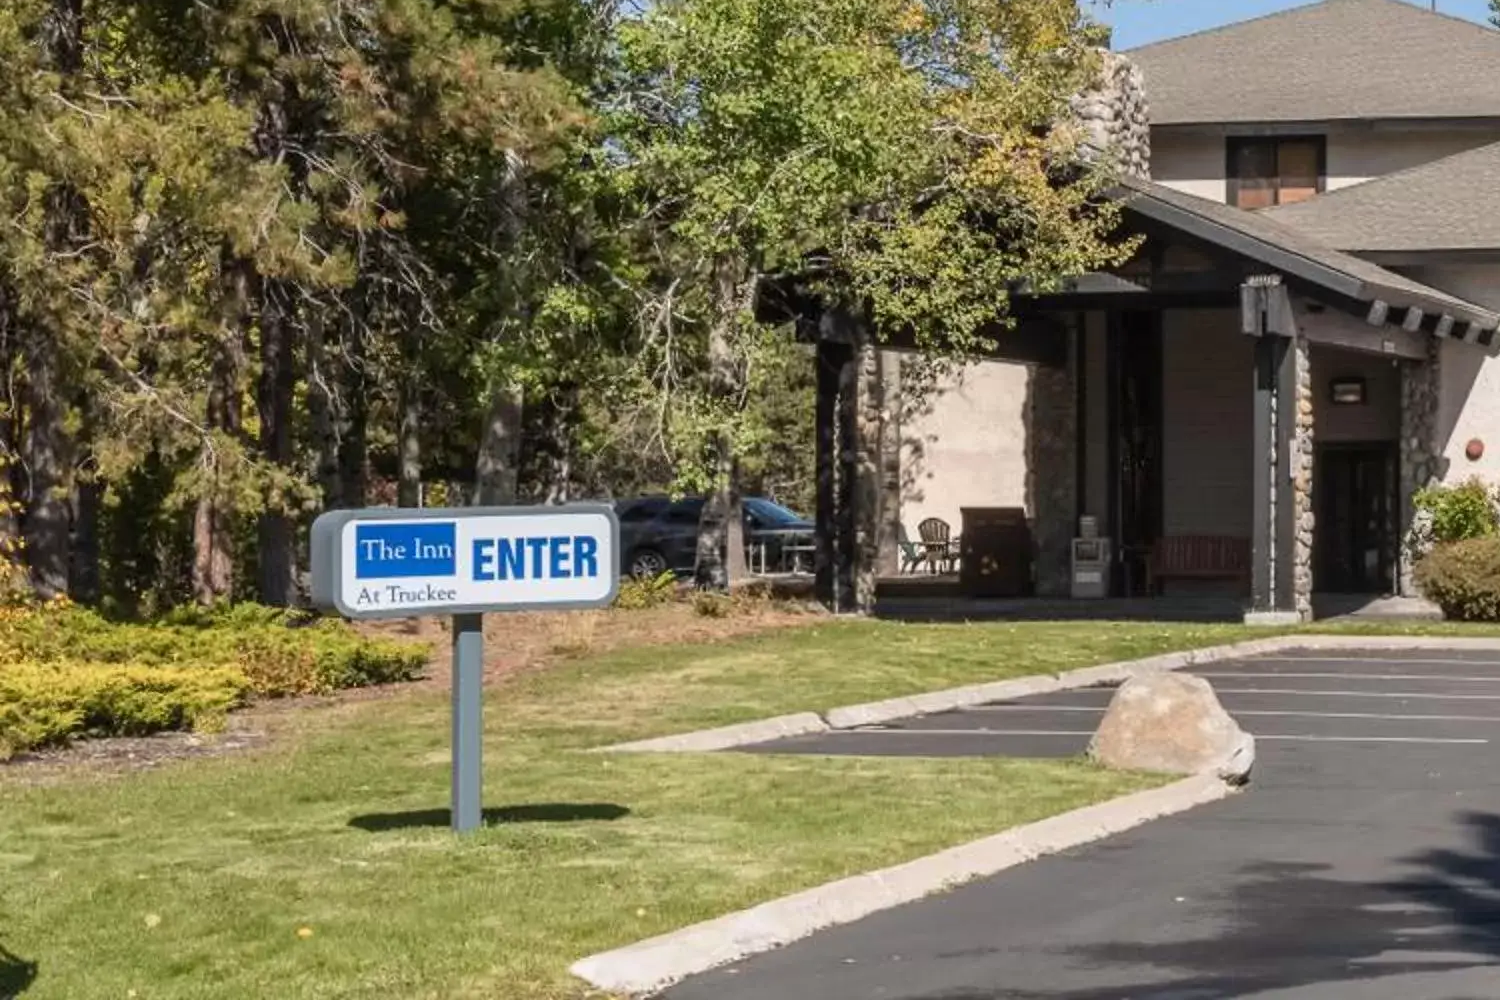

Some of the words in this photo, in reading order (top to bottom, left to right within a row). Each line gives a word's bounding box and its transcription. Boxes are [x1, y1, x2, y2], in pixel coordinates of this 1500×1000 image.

[360, 538, 407, 561] The
[413, 537, 453, 560] Inn
[472, 536, 598, 581] ENTER
[357, 587, 381, 605] At
[385, 584, 457, 603] Truckee
